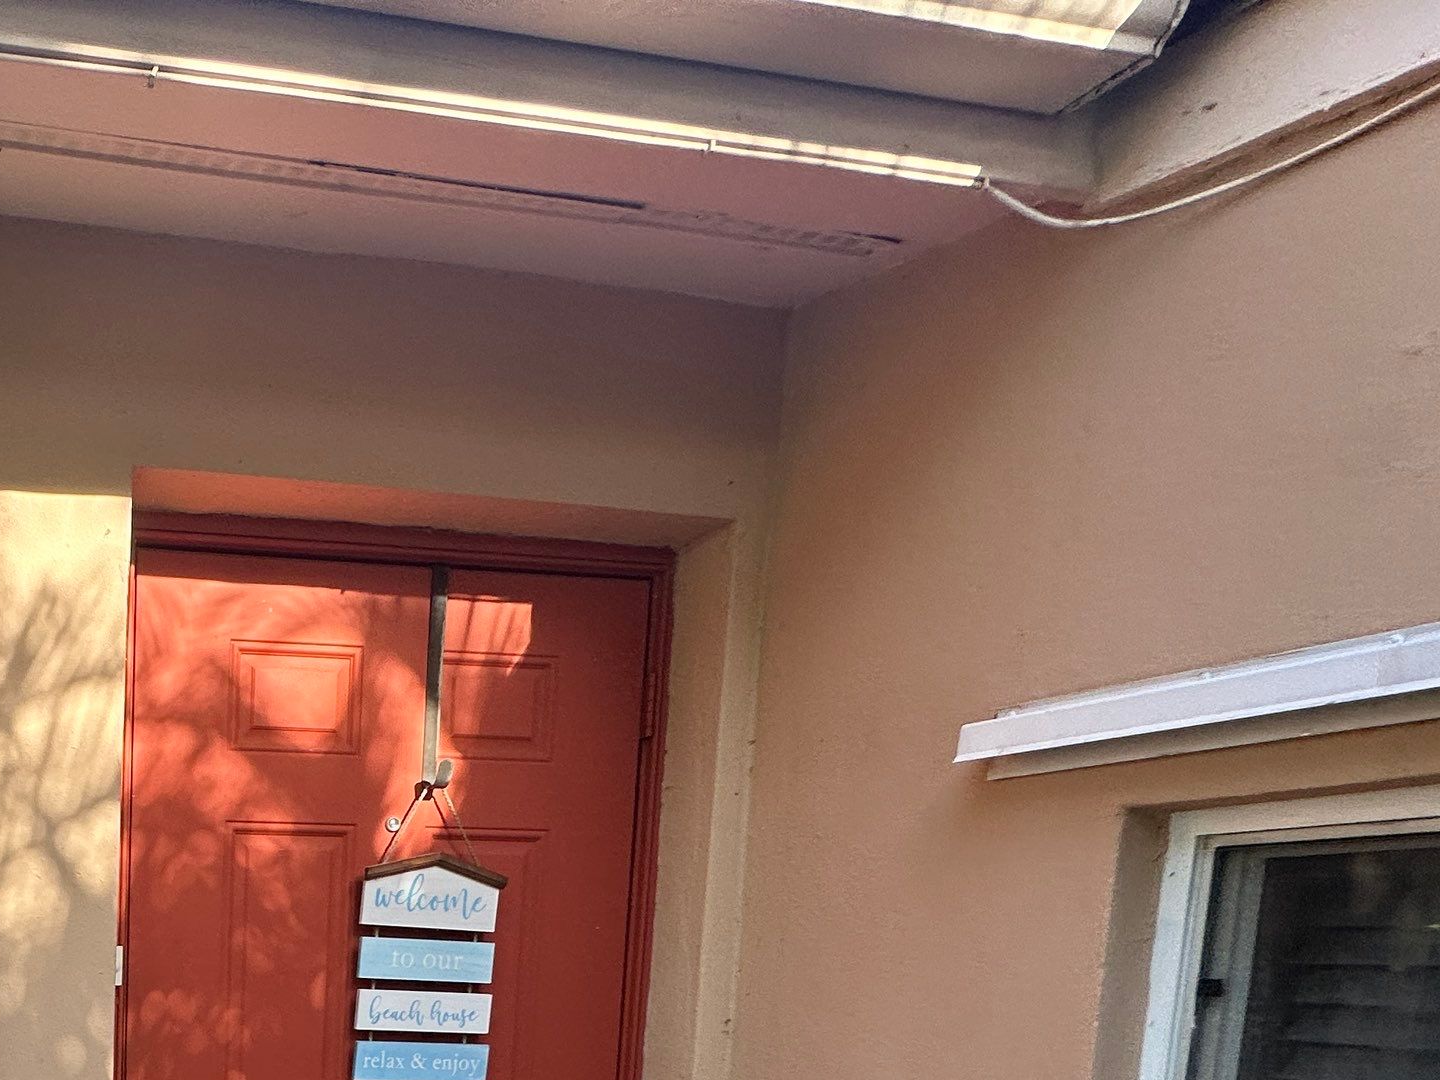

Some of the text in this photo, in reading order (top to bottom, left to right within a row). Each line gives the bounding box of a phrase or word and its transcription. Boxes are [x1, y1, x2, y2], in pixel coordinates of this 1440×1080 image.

[375, 873, 487, 919] welcome
[392, 950, 464, 972] to our
[369, 995, 479, 1028] beach house
[362, 1050, 481, 1077] relax & enjoy
